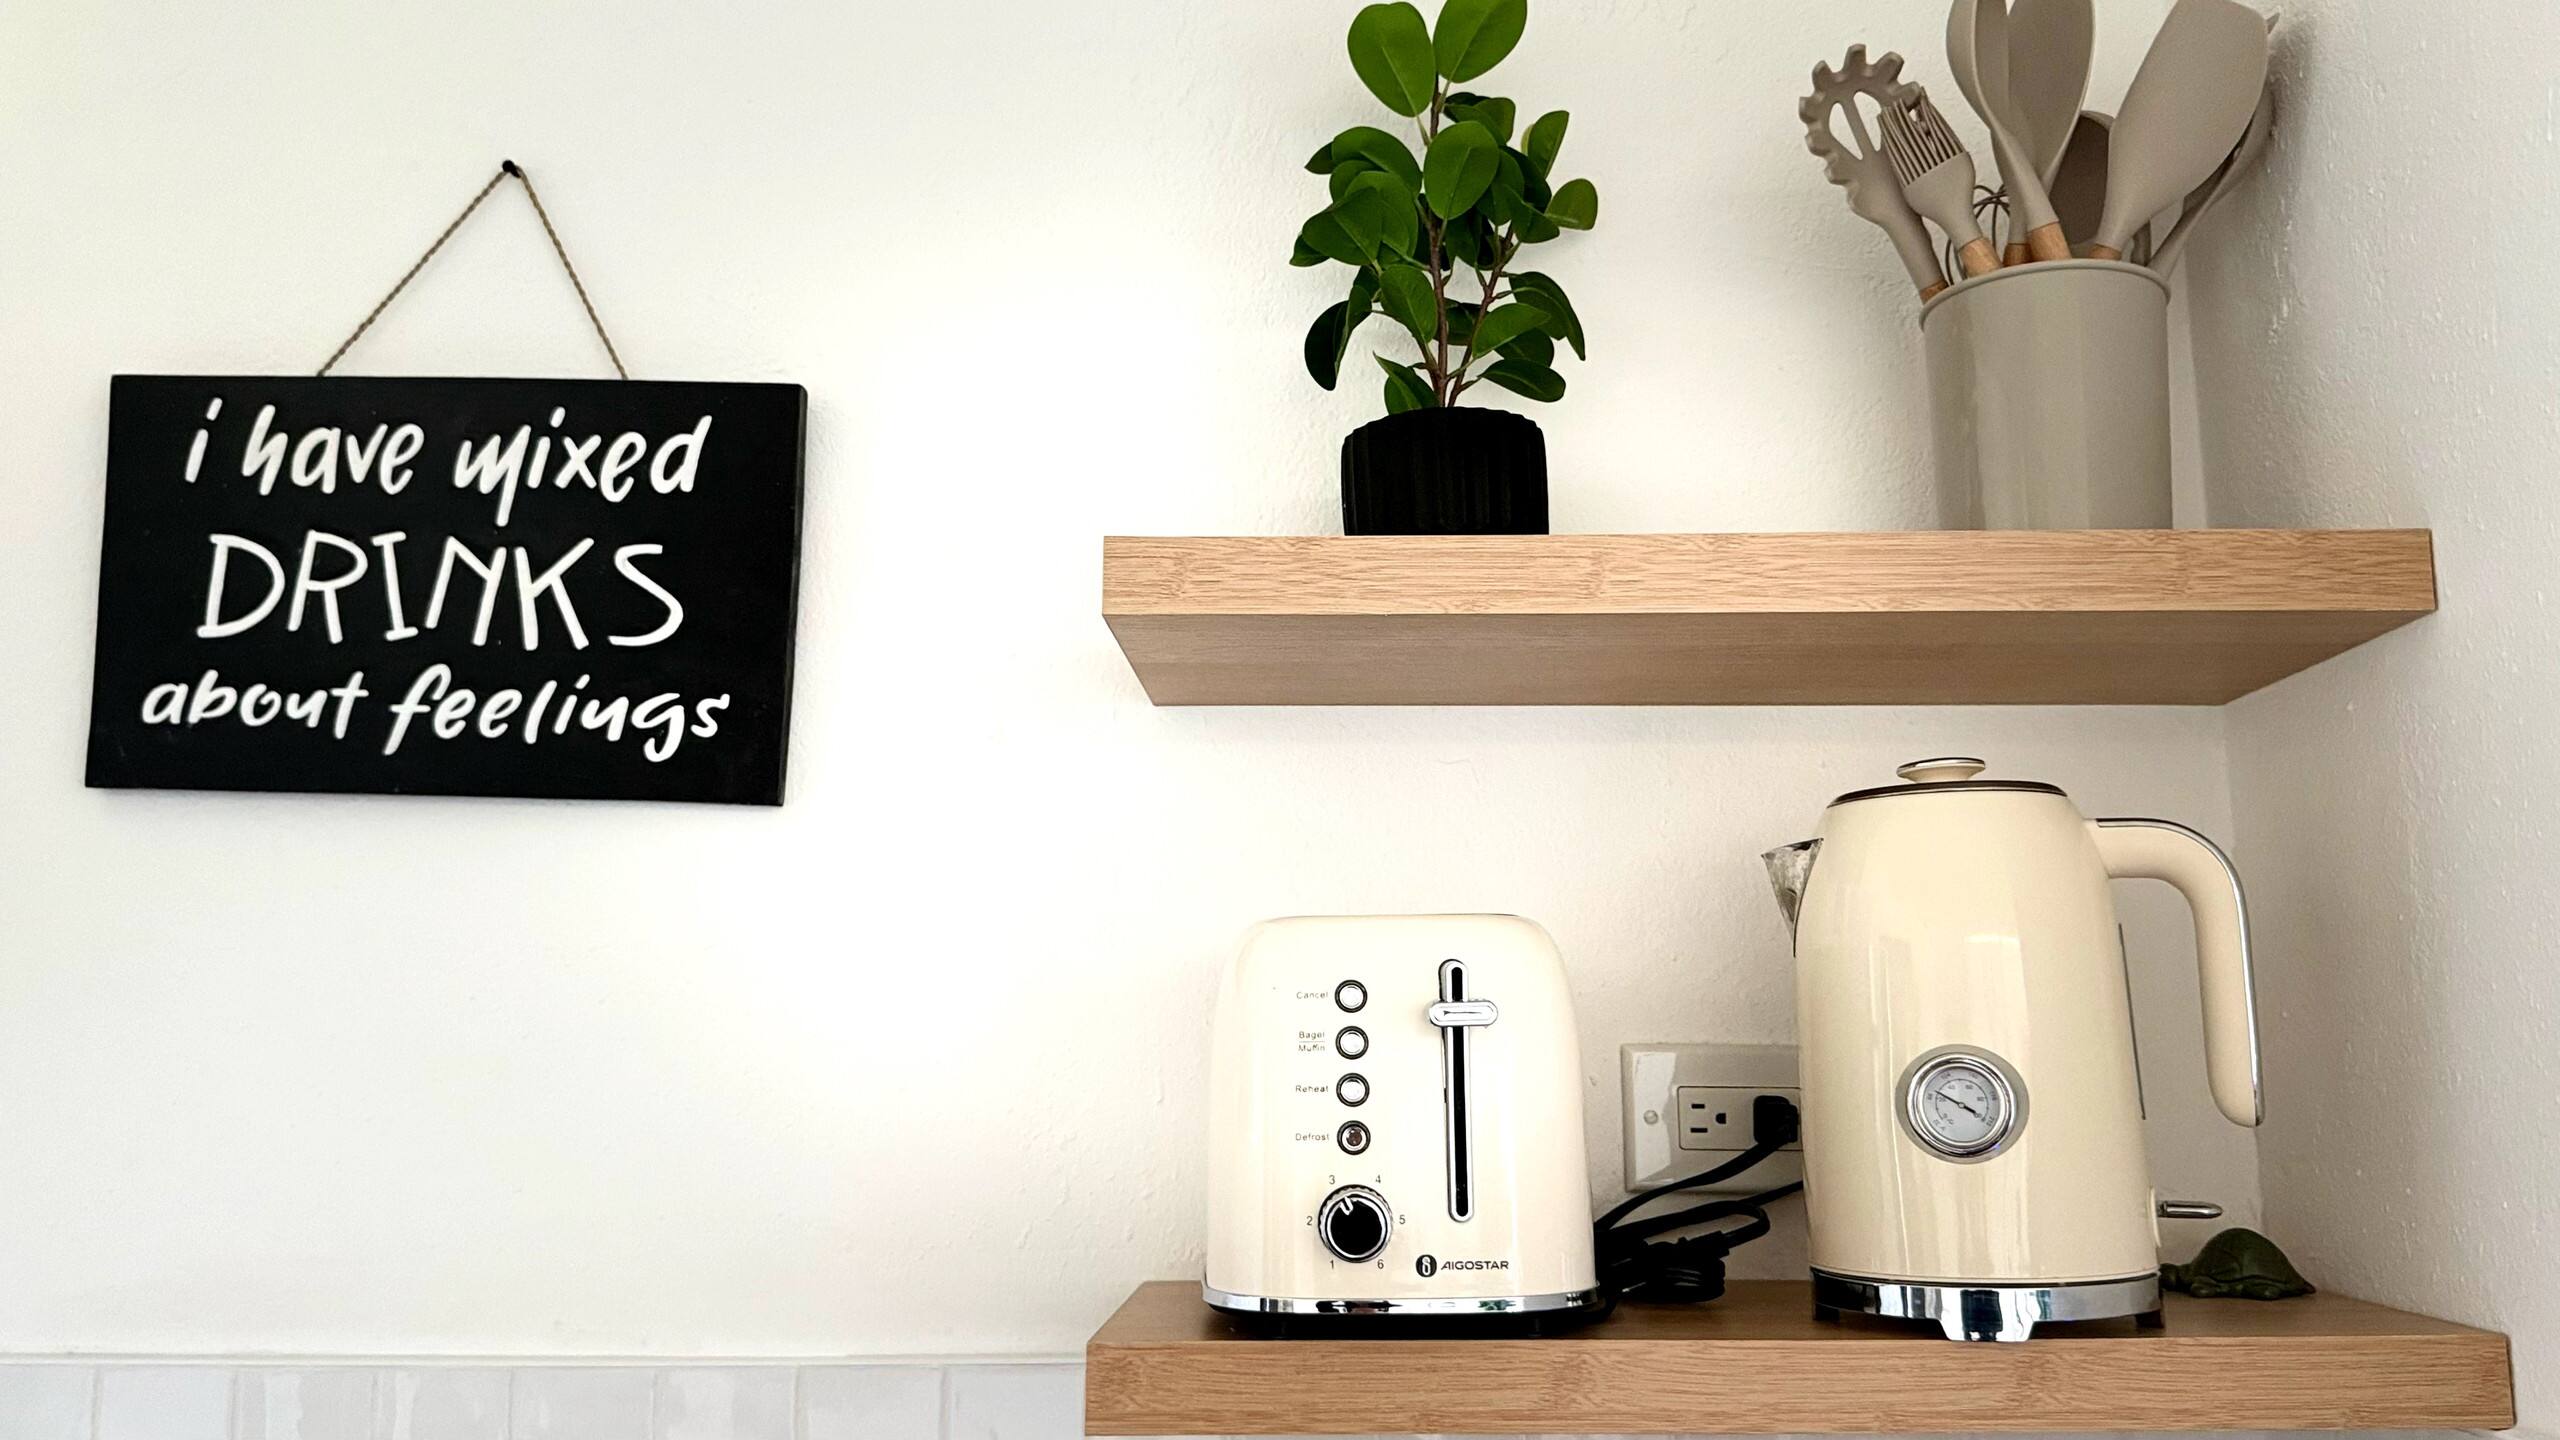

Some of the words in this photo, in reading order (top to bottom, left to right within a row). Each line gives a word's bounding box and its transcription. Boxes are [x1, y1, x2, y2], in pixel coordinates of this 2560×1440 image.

[186, 398, 222, 482] i
[242, 405, 424, 495] have
[455, 407, 712, 526] mixed
[197, 530, 683, 650] DRINKS
[143, 670, 368, 739] about
[384, 664, 730, 762] feelings
[1296, 991, 1329, 1000] Cancel
[1298, 1031, 1325, 1041] Bagel
[1298, 1044, 1326, 1052] Muffin
[1295, 1085, 1329, 1093] Reheat
[1295, 1133, 1330, 1142] Defrost
[1329, 1174, 1336, 1185] 3
[1375, 1174, 1382, 1184] 4
[1306, 1215, 1313, 1226] 2
[1399, 1214, 1406, 1225] 5
[1329, 1259, 1335, 1270] 1
[1377, 1259, 1385, 1270] 6
[1440, 1260, 1509, 1271] AIGOSTAR
